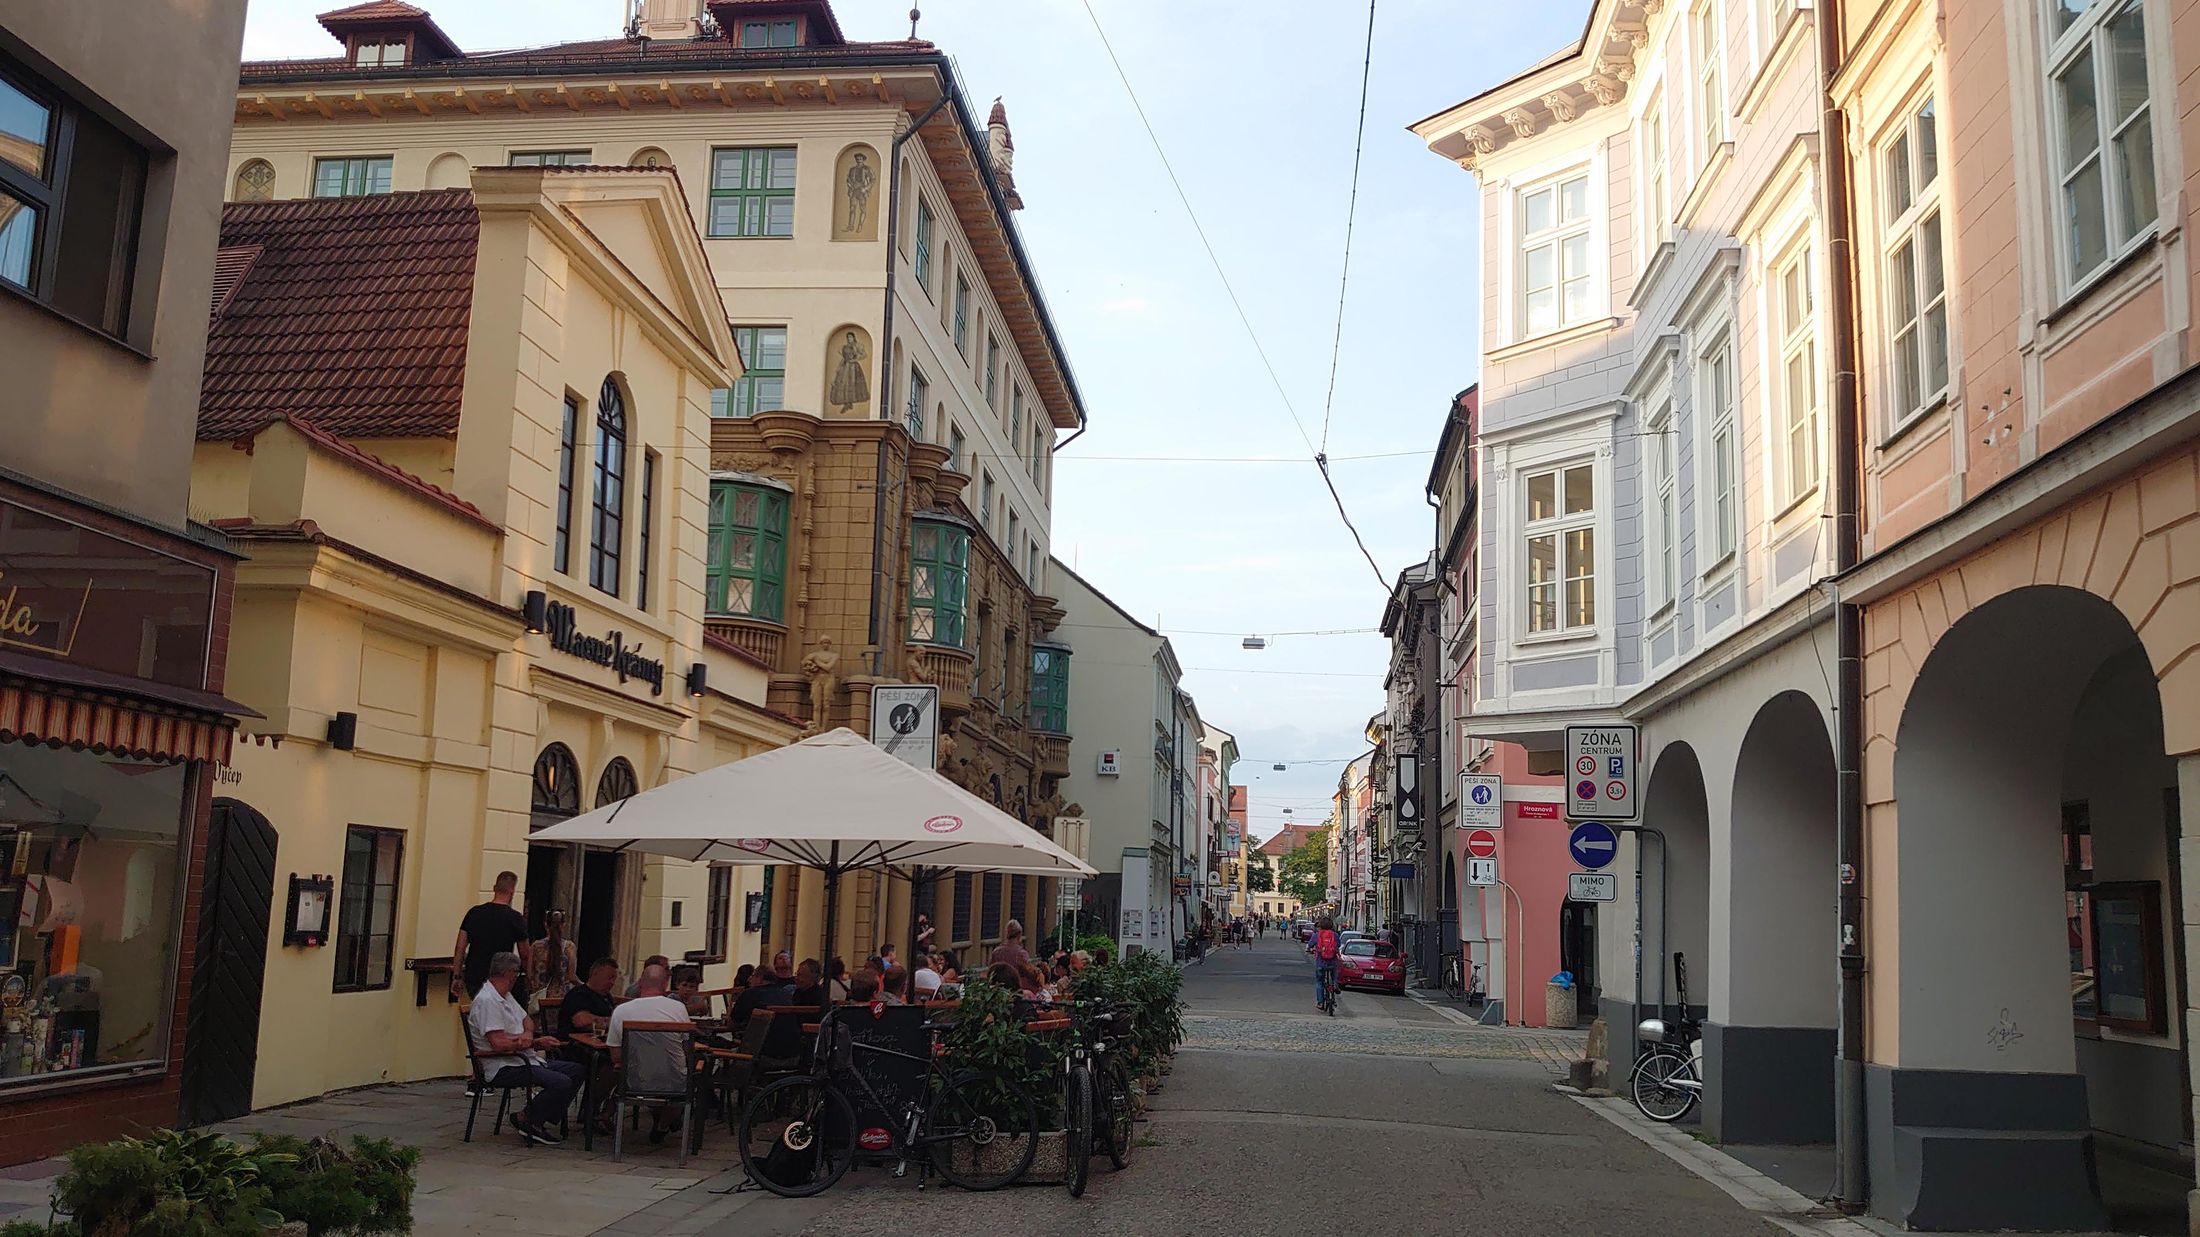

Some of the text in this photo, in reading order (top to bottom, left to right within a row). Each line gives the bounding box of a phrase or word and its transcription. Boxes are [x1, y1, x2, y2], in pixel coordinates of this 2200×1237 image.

[1580, 729, 1622, 746] ZÓNA
[1580, 747, 1622, 755] CENTRUM
[1101, 765, 1116, 773] KB
[1580, 760, 1593, 771] 30
[1611, 758, 1621, 772] P
[1523, 804, 1553, 813] Hroznová
[1579, 876, 1605, 885] MIMO
